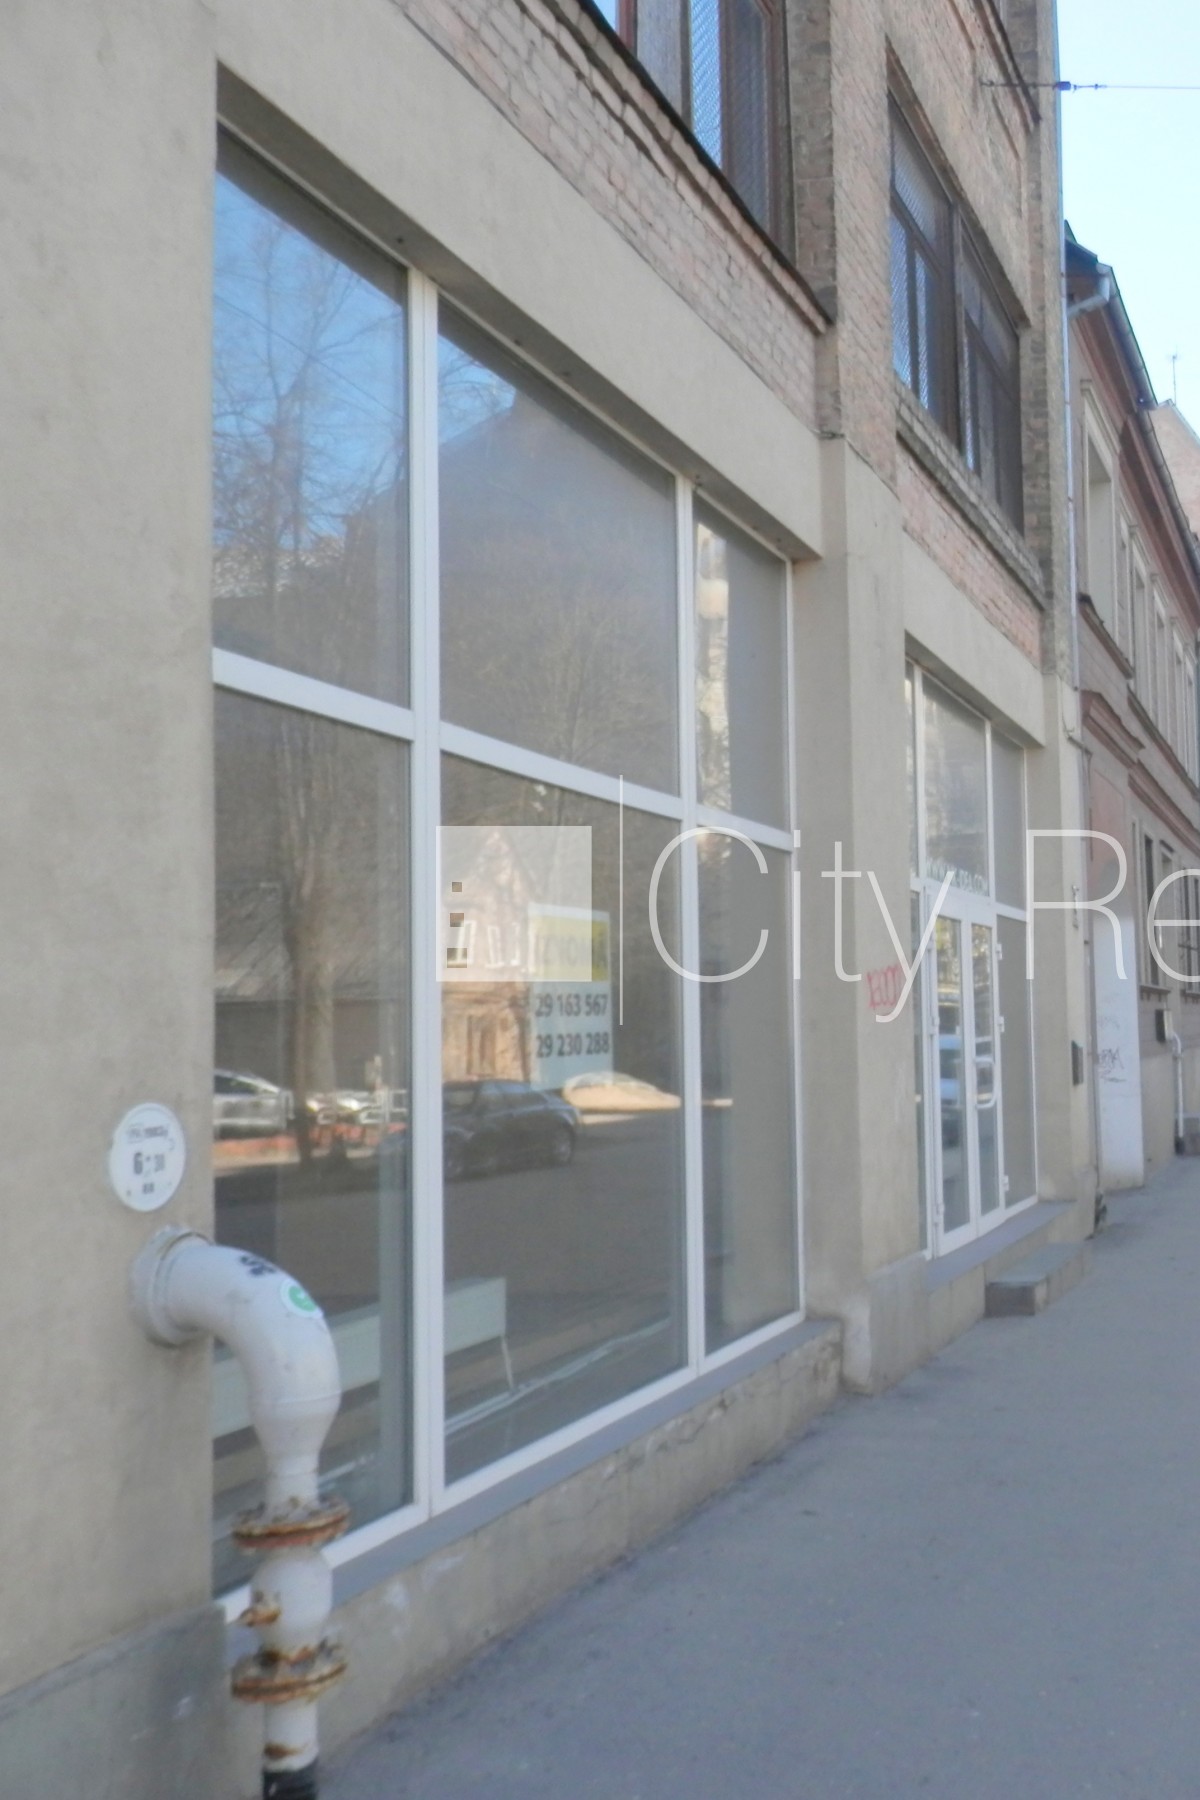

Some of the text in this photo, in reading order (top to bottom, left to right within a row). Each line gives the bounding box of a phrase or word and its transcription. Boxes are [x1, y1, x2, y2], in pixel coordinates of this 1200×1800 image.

[535, 994, 553, 1017] 29
[557, 994, 582, 1017] 163
[536, 1031, 609, 1058] 29 230 288
